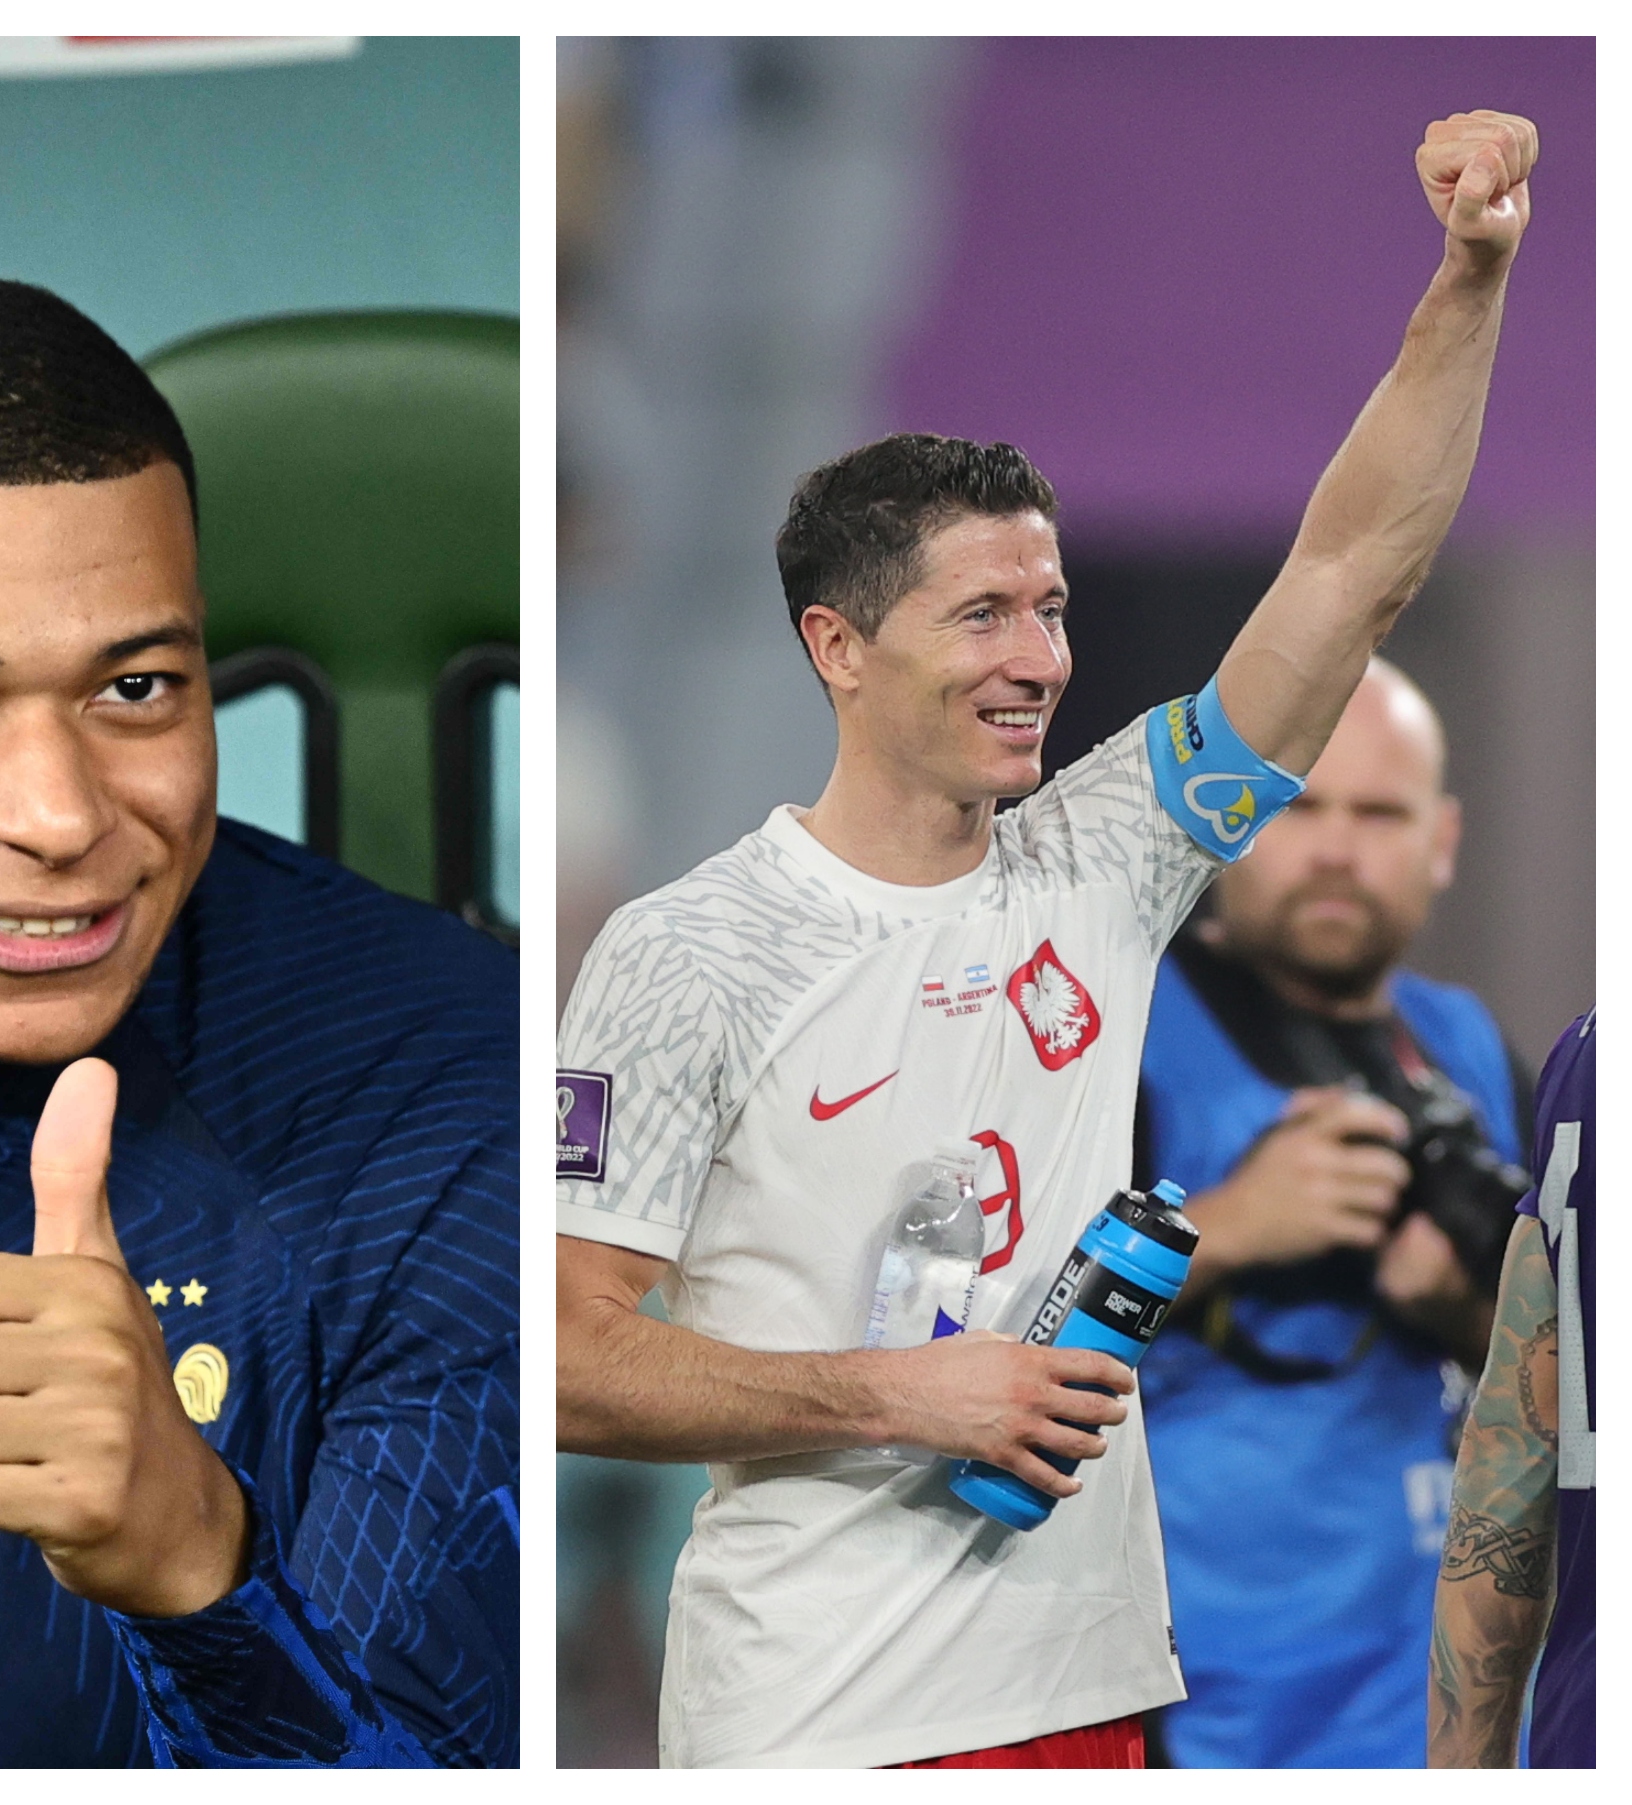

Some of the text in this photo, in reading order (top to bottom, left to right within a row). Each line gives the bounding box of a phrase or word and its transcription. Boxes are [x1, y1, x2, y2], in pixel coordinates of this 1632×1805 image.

[922, 997, 951, 1008] POLAND
[957, 984, 998, 1002] ARGENTINA
[573, 1145, 589, 1154] CUP
[962, 1264, 979, 1328] water
[1109, 1290, 1142, 1315] POWER
